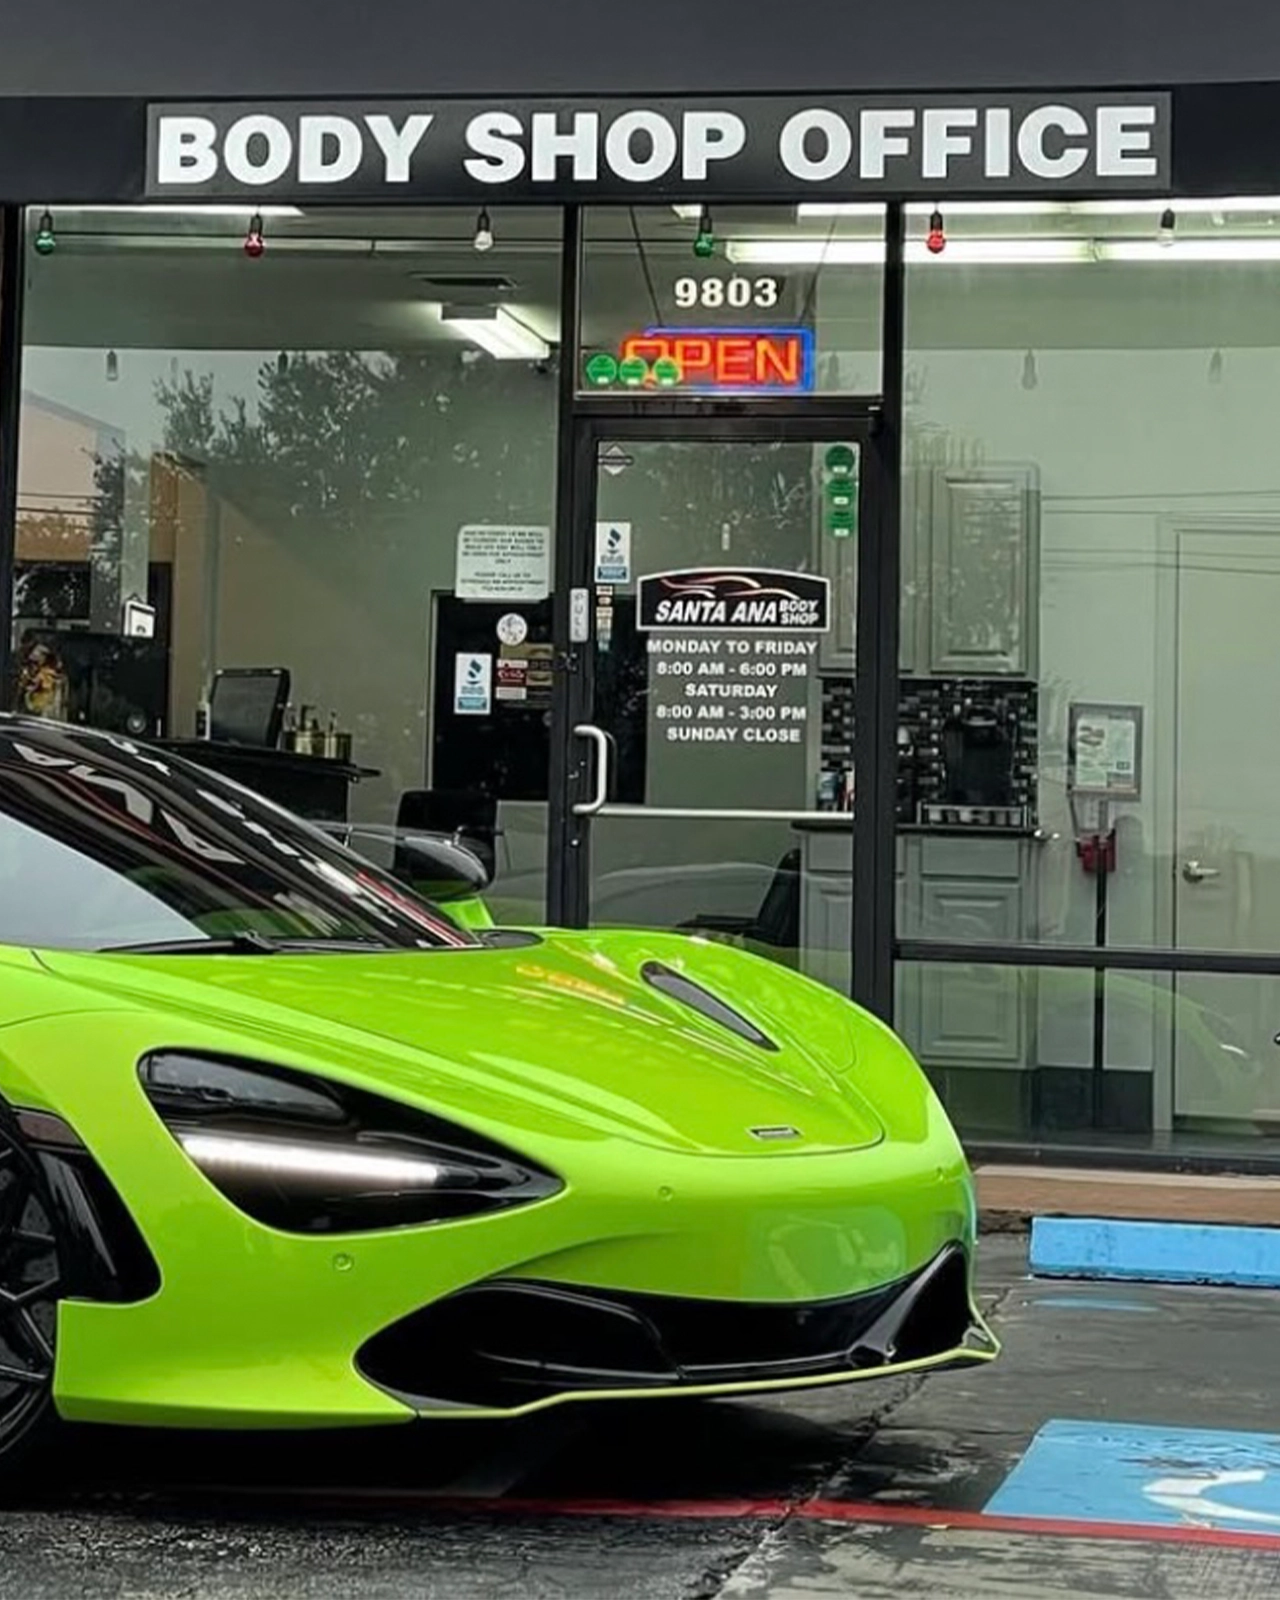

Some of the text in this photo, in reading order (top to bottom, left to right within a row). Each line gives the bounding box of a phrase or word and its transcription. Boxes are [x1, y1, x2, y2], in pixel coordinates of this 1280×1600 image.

[158, 105, 1158, 185] BODY SHOP OFFICE
[674, 277, 778, 308] 9803
[622, 336, 801, 387] OPEN
[655, 600, 777, 625] SANTA ANA
[779, 600, 819, 613] BODY
[780, 612, 819, 625] SHOP
[647, 640, 818, 655] MONDAY TO FRIDAY
[656, 661, 693, 676] 8:00
[697, 662, 725, 676] AM
[739, 662, 776, 676] 6:00
[781, 663, 807, 677] PM
[685, 683, 779, 698] SATURDAY
[656, 705, 693, 719] 8:00
[697, 706, 725, 719] AM
[739, 706, 776, 720] 3:00
[780, 707, 807, 720] PM
[667, 727, 801, 742] SUNDAY CLOSE
